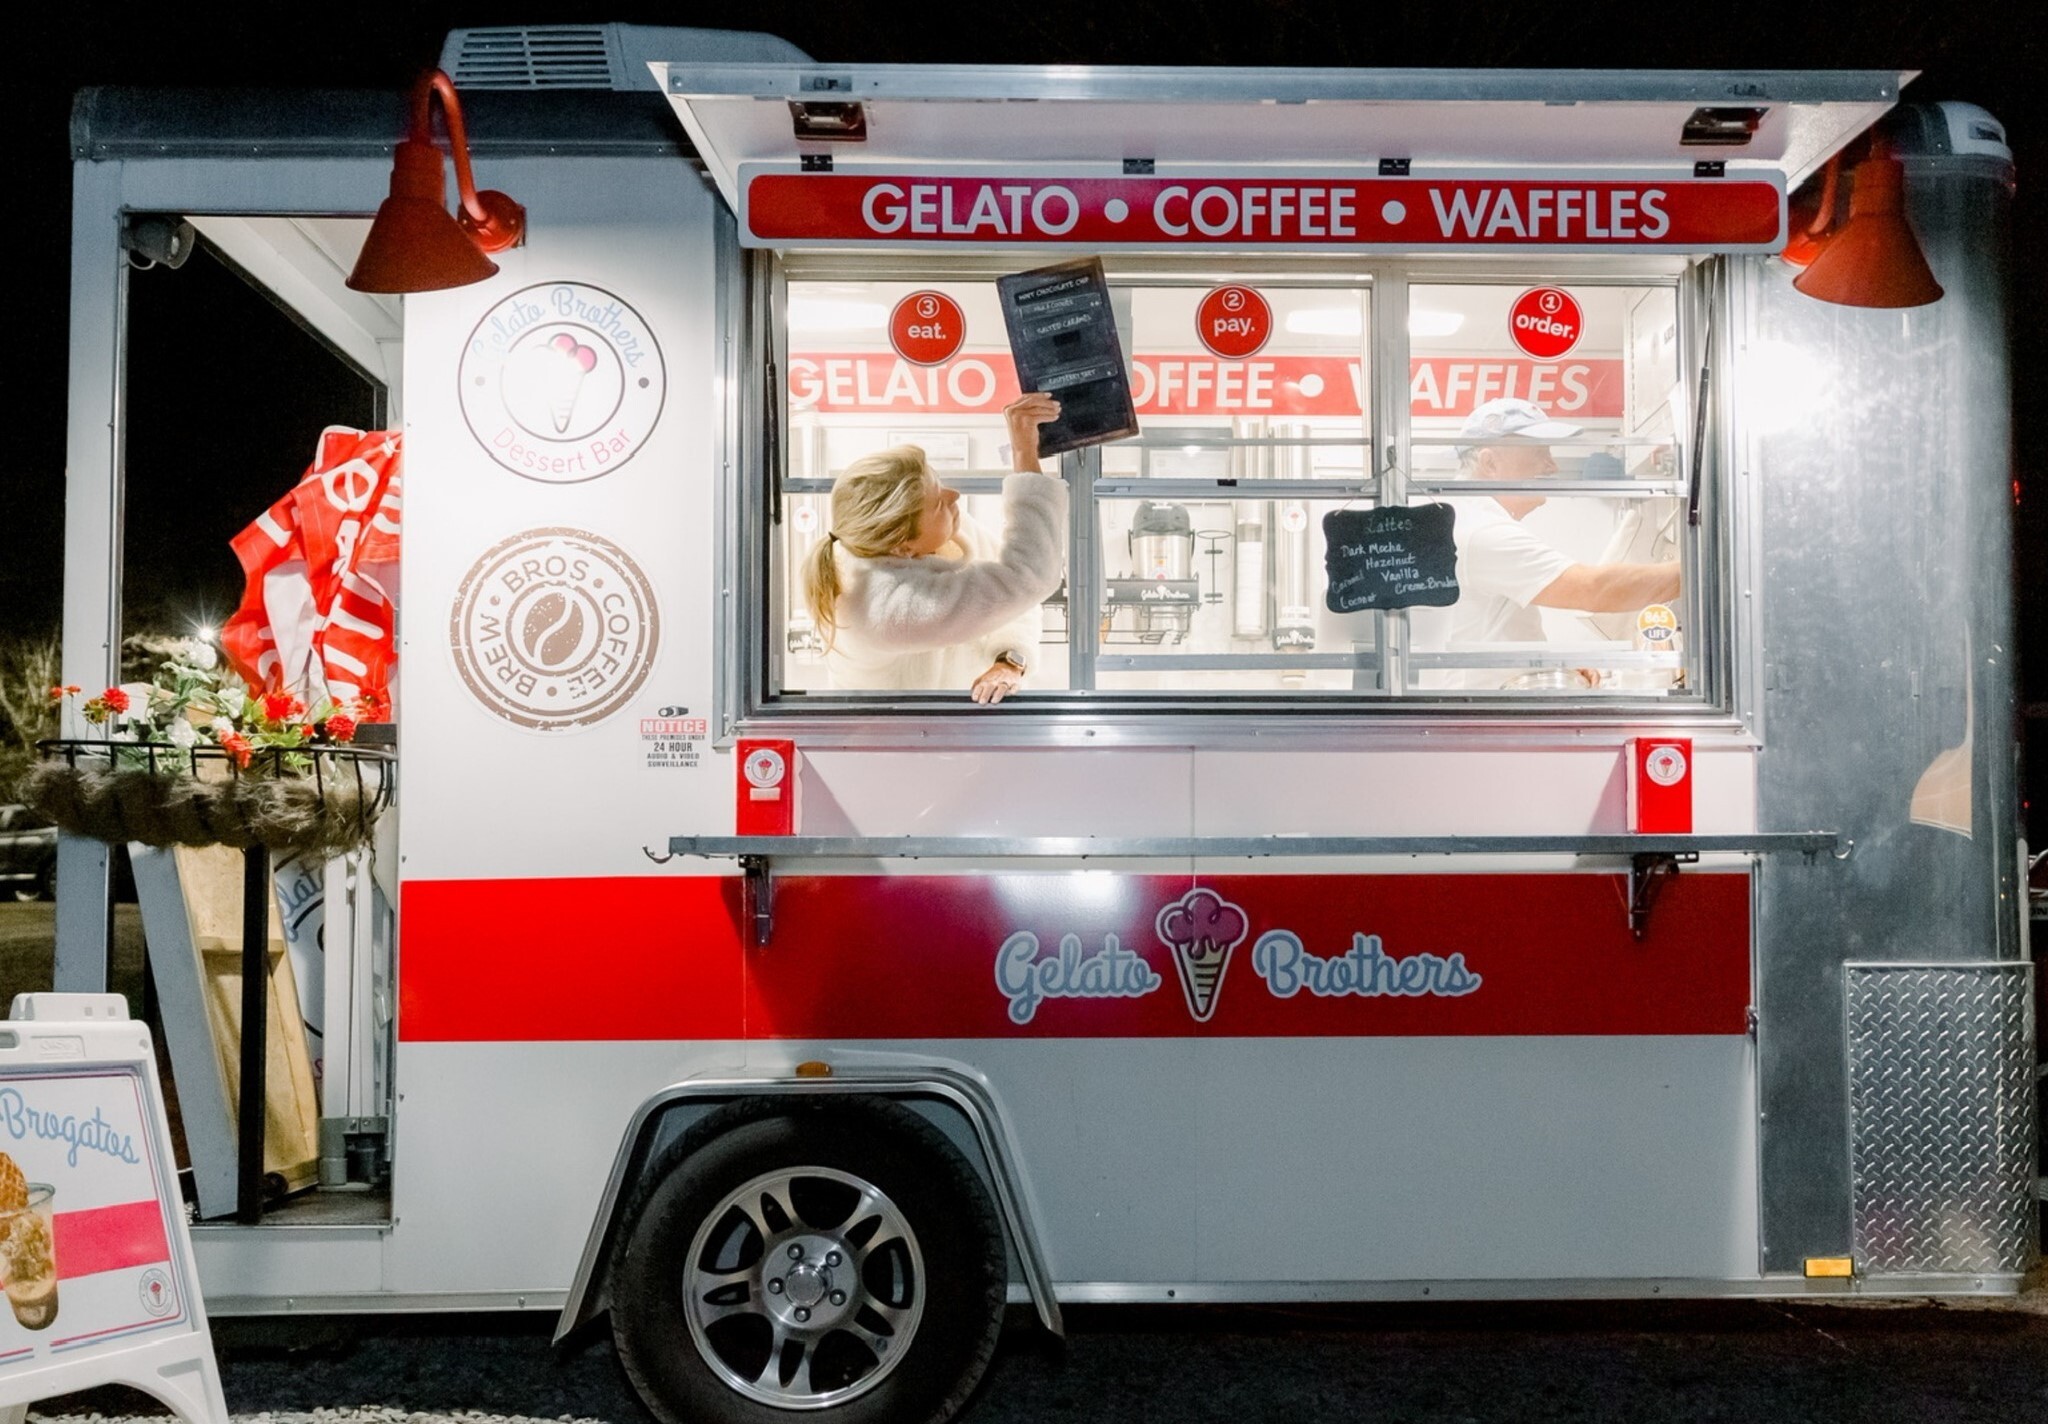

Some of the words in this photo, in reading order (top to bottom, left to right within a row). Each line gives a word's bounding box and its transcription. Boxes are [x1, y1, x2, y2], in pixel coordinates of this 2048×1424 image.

[861, 183, 1080, 235] GELATO
[1153, 186, 1357, 237] COFFEE
[1428, 188, 1670, 239] WAFFLES
[922, 299, 935, 315] 3
[1227, 293, 1240, 307] 2
[1545, 296, 1556, 309] 1
[551, 286, 645, 368] Brothers
[907, 322, 947, 339] eat.
[1213, 317, 1256, 337] pay.
[1515, 314, 1574, 340] order.
[789, 358, 996, 407] GELATO
[493, 427, 586, 473] Dessert
[590, 428, 631, 465] Bar
[1365, 517, 1414, 534] Lattes
[1340, 544, 1366, 558] Dark
[1368, 541, 1404, 554] Mocha
[1366, 553, 1416, 570] Hazelnut
[501, 555, 590, 594] BROS
[1381, 567, 1420, 582] Vanilla
[479, 613, 537, 698] BREW
[567, 592, 630, 700] COFFEE
[642, 720, 705, 733] NOTICE
[653, 742, 665, 752] 24
[669, 742, 693, 752] HOUR
[996, 931, 1160, 1023] Gelato
[1253, 931, 1481, 997] Brothers
[0, 1087, 140, 1168] Brogatos
